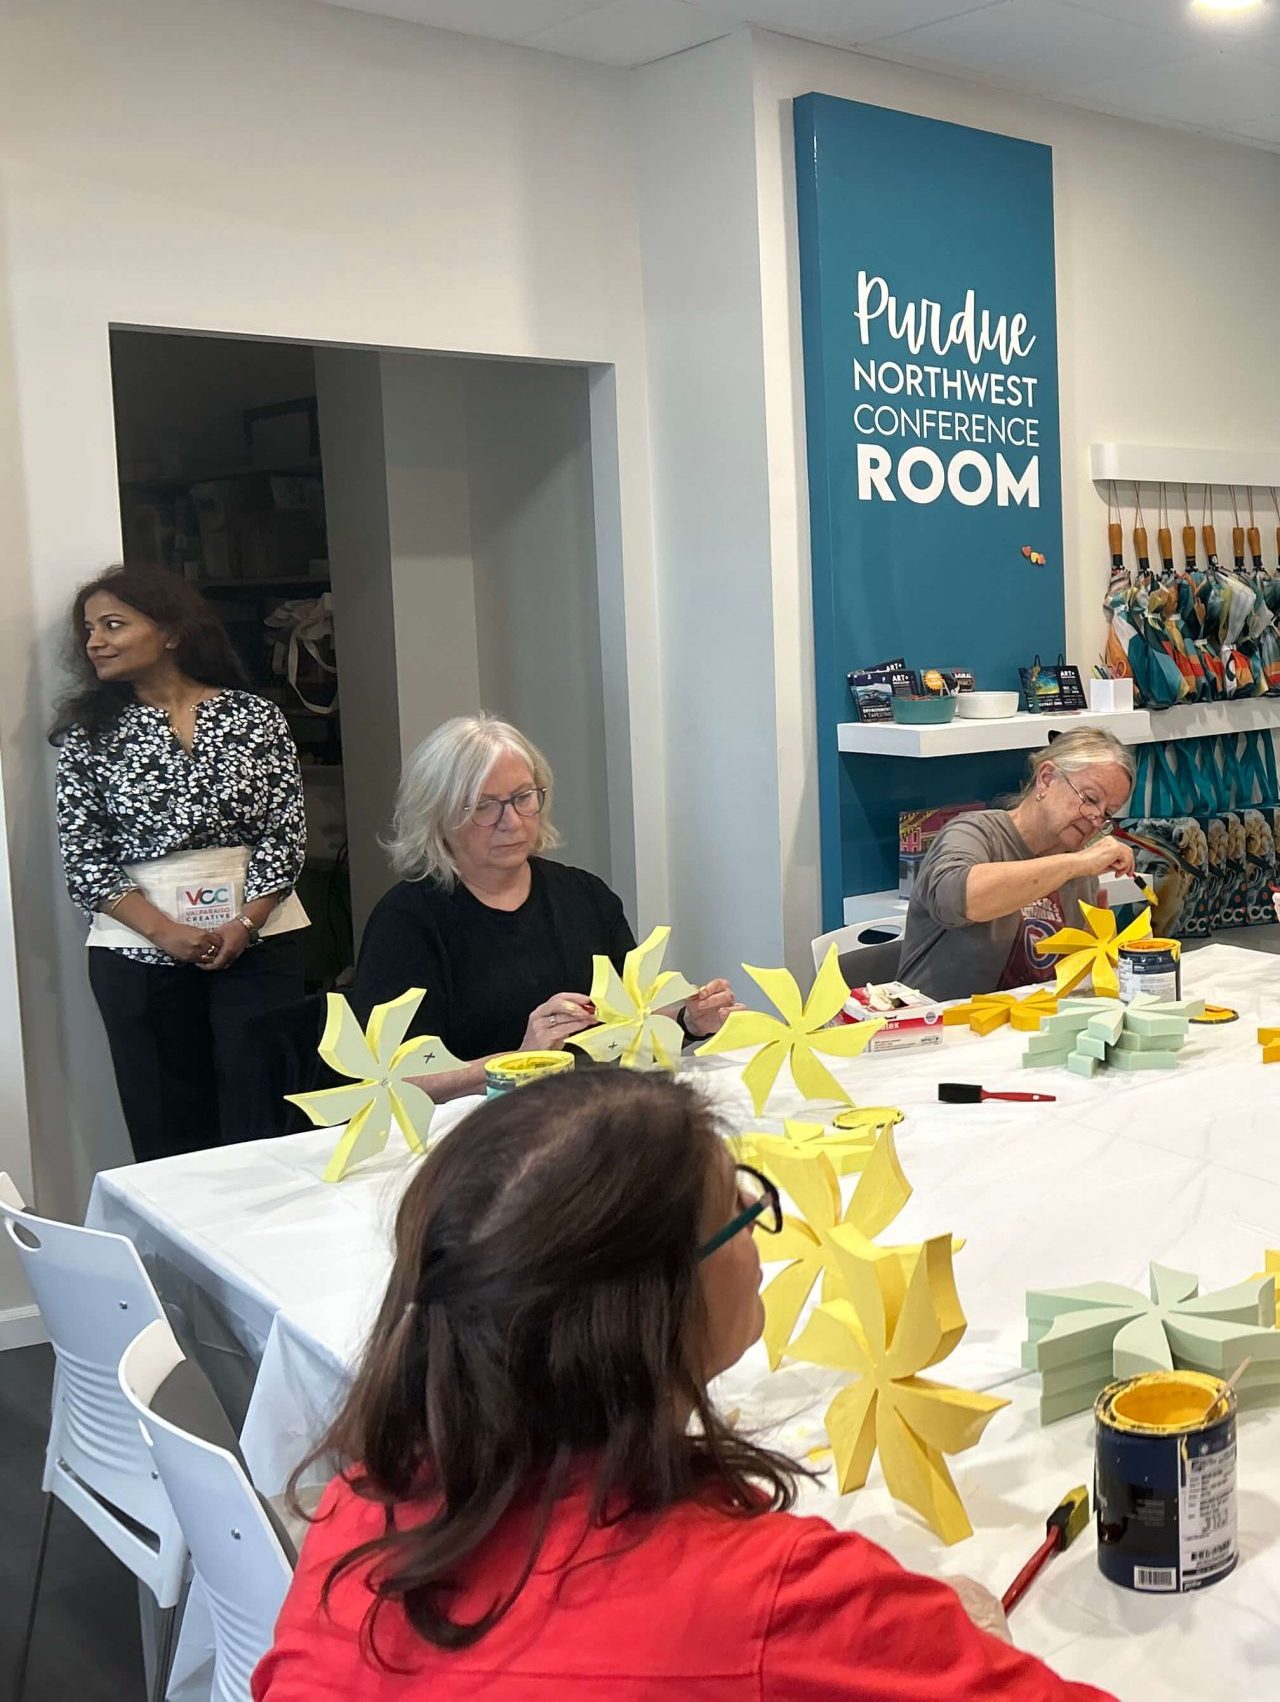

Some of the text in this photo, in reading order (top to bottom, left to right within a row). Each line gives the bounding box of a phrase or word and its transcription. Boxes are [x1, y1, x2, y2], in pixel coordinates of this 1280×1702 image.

[854, 270, 1036, 365] Purdue
[854, 358, 1038, 408] NORTHWEST
[854, 403, 1039, 447] CONFERENCE
[856, 443, 1040, 508] ROOM
[185, 888, 229, 905] VCC
[185, 913, 231, 922] CREATIVE
